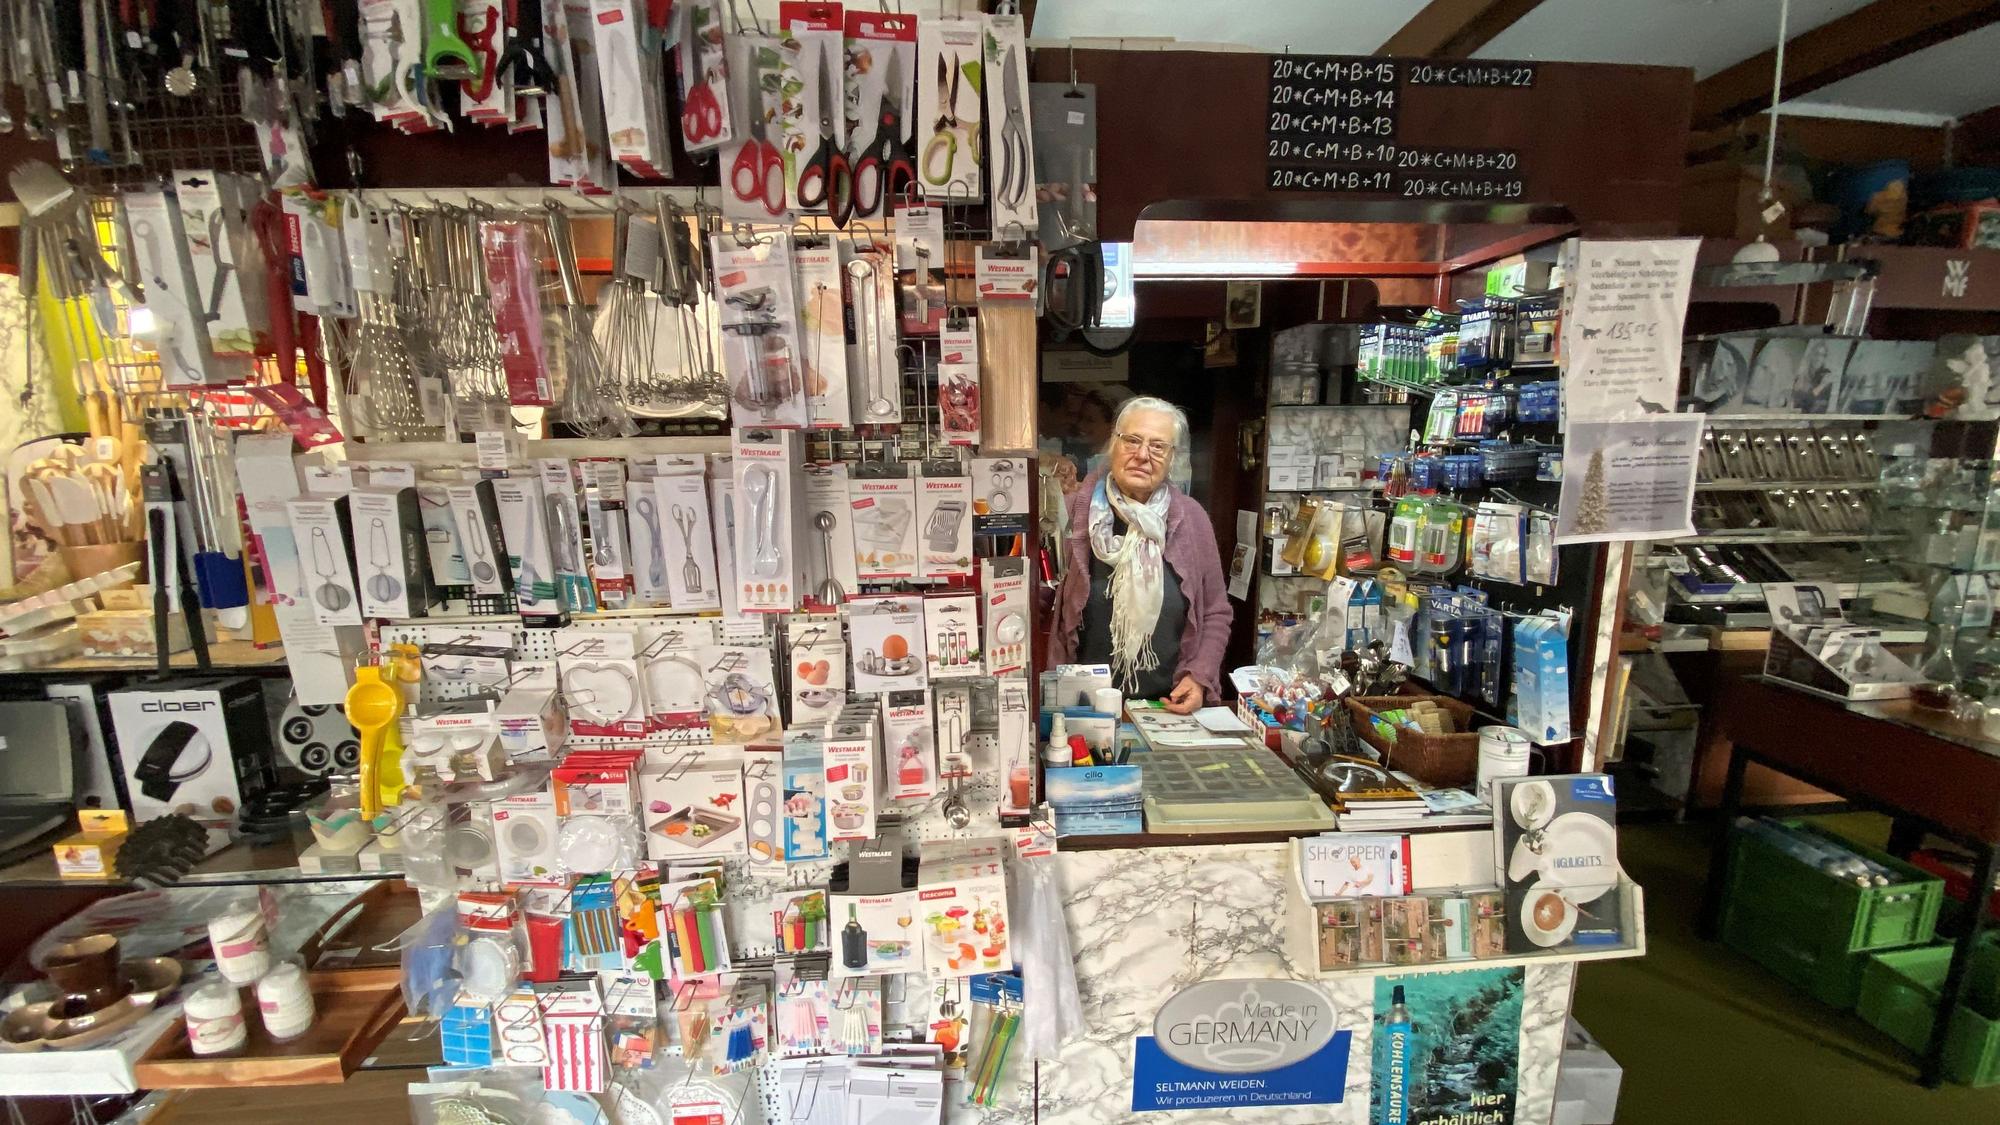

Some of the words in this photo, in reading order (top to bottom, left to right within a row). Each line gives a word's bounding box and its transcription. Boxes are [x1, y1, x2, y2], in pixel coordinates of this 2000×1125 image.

[987, 264, 1025, 273] WESTMARK
[1468, 310, 1491, 322] VARTA
[740, 448, 782, 457] WESTMARK
[862, 483, 899, 491] WESTMARK
[993, 580, 1023, 589] WESTMARK
[1431, 599, 1462, 616] VARTA
[141, 699, 216, 713] cloer
[436, 719, 473, 727] WESTMARK
[828, 746, 866, 754] WESTMARK
[1243, 1003, 1294, 1018] Made
[1301, 1004, 1318, 1017] in
[1168, 1019, 1318, 1046] GERMANY
[1156, 1081, 1216, 1092] SELTMANN
[1156, 1096, 1174, 1106] Wir
[1175, 1093, 1236, 1106] produzieren
[1238, 1093, 1248, 1101] in
[1250, 1091, 1312, 1101] Deutschland
[1470, 1092, 1506, 1106] hier
